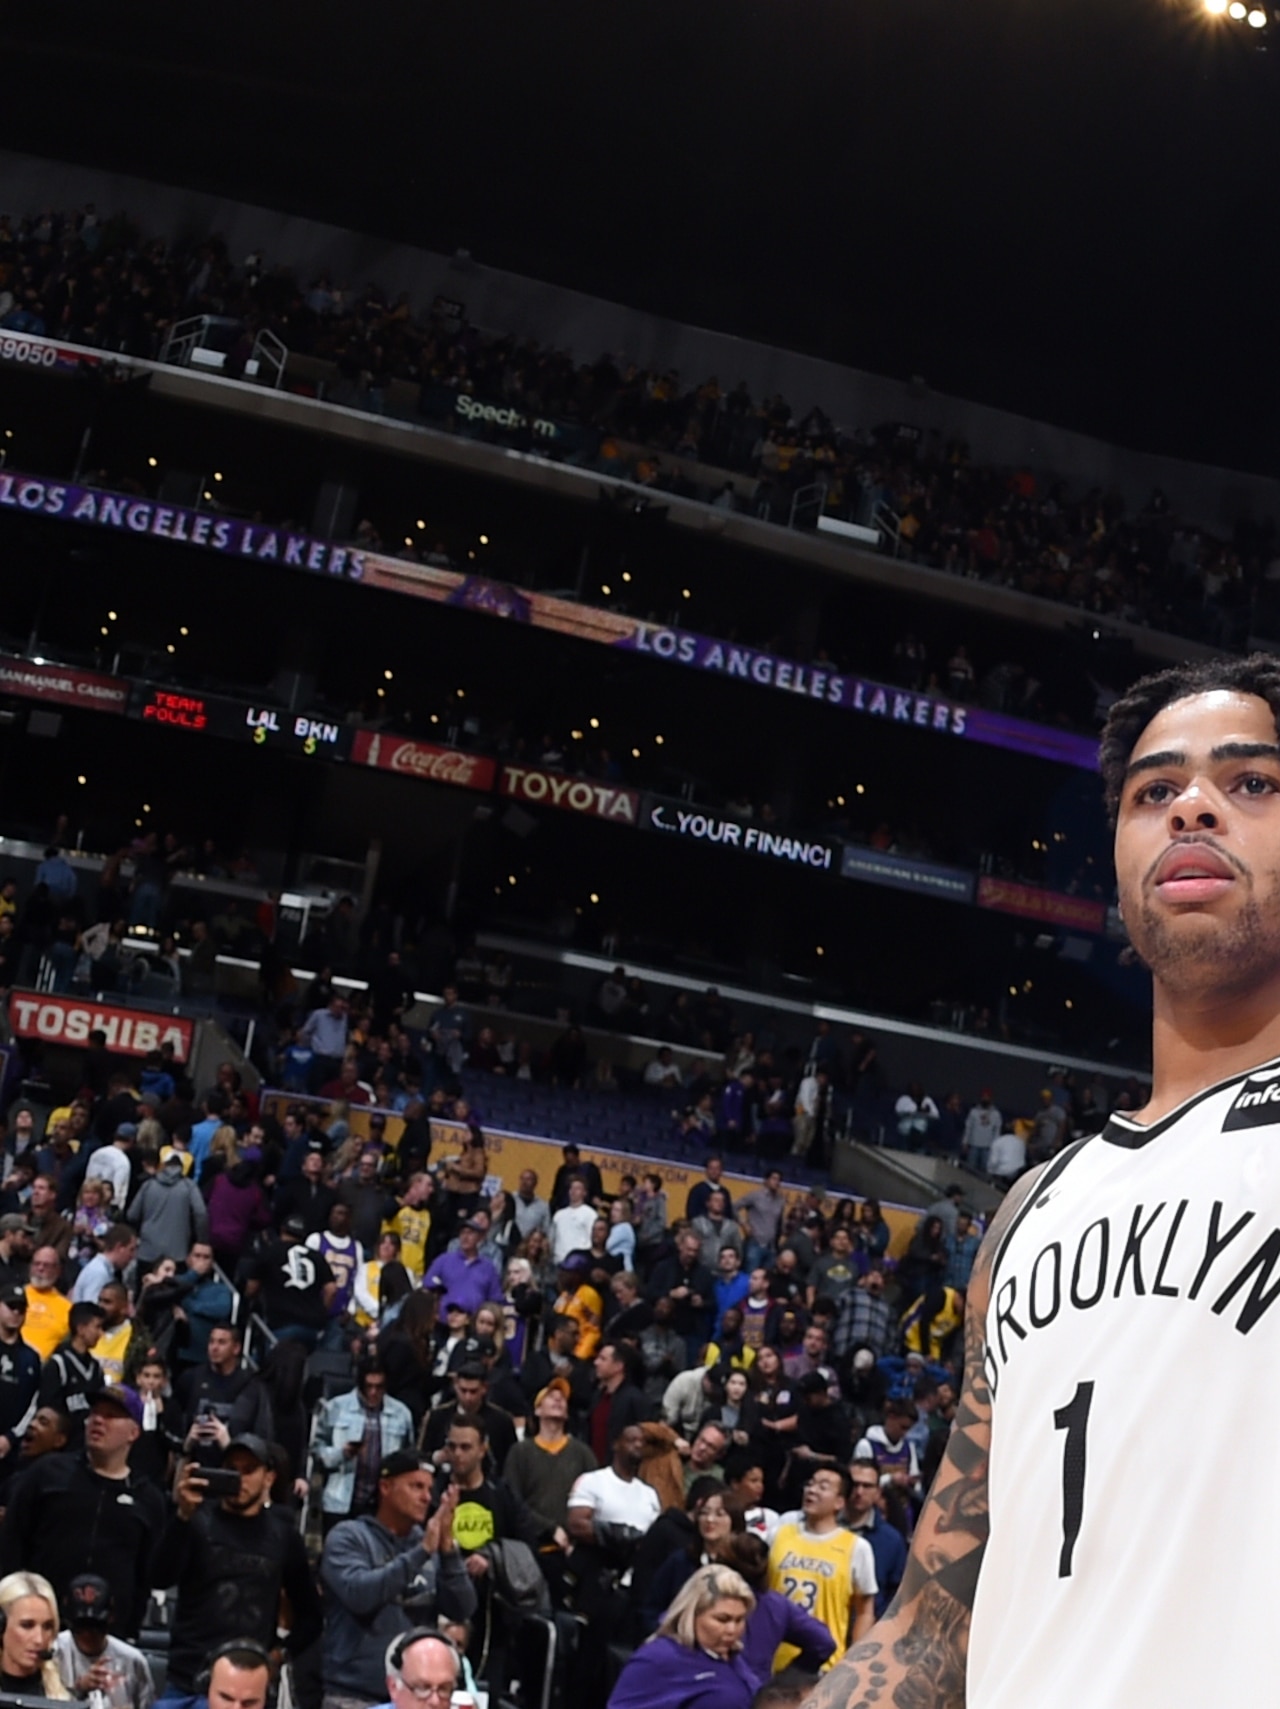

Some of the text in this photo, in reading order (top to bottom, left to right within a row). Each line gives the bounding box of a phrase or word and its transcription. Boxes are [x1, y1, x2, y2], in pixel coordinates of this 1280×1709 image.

[0, 338, 57, 367] 9050
[456, 395, 556, 437] Spectm
[0, 473, 366, 580] LOS ANGELES LAKERS
[77, 683, 124, 702] CASINO
[635, 627, 968, 735] LOS ANGELES LAKERS
[143, 705, 207, 730] FOULS
[155, 692, 204, 712] TEAM
[246, 707, 338, 742] LAL BKN
[503, 766, 634, 822] TOYOTA
[744, 828, 832, 869] FINANCI
[15, 1000, 184, 1058] TOSHIBA
[1054, 1380, 1096, 1578] 1
[778, 1551, 835, 1578] LAKERS
[783, 1577, 817, 1612] 23
